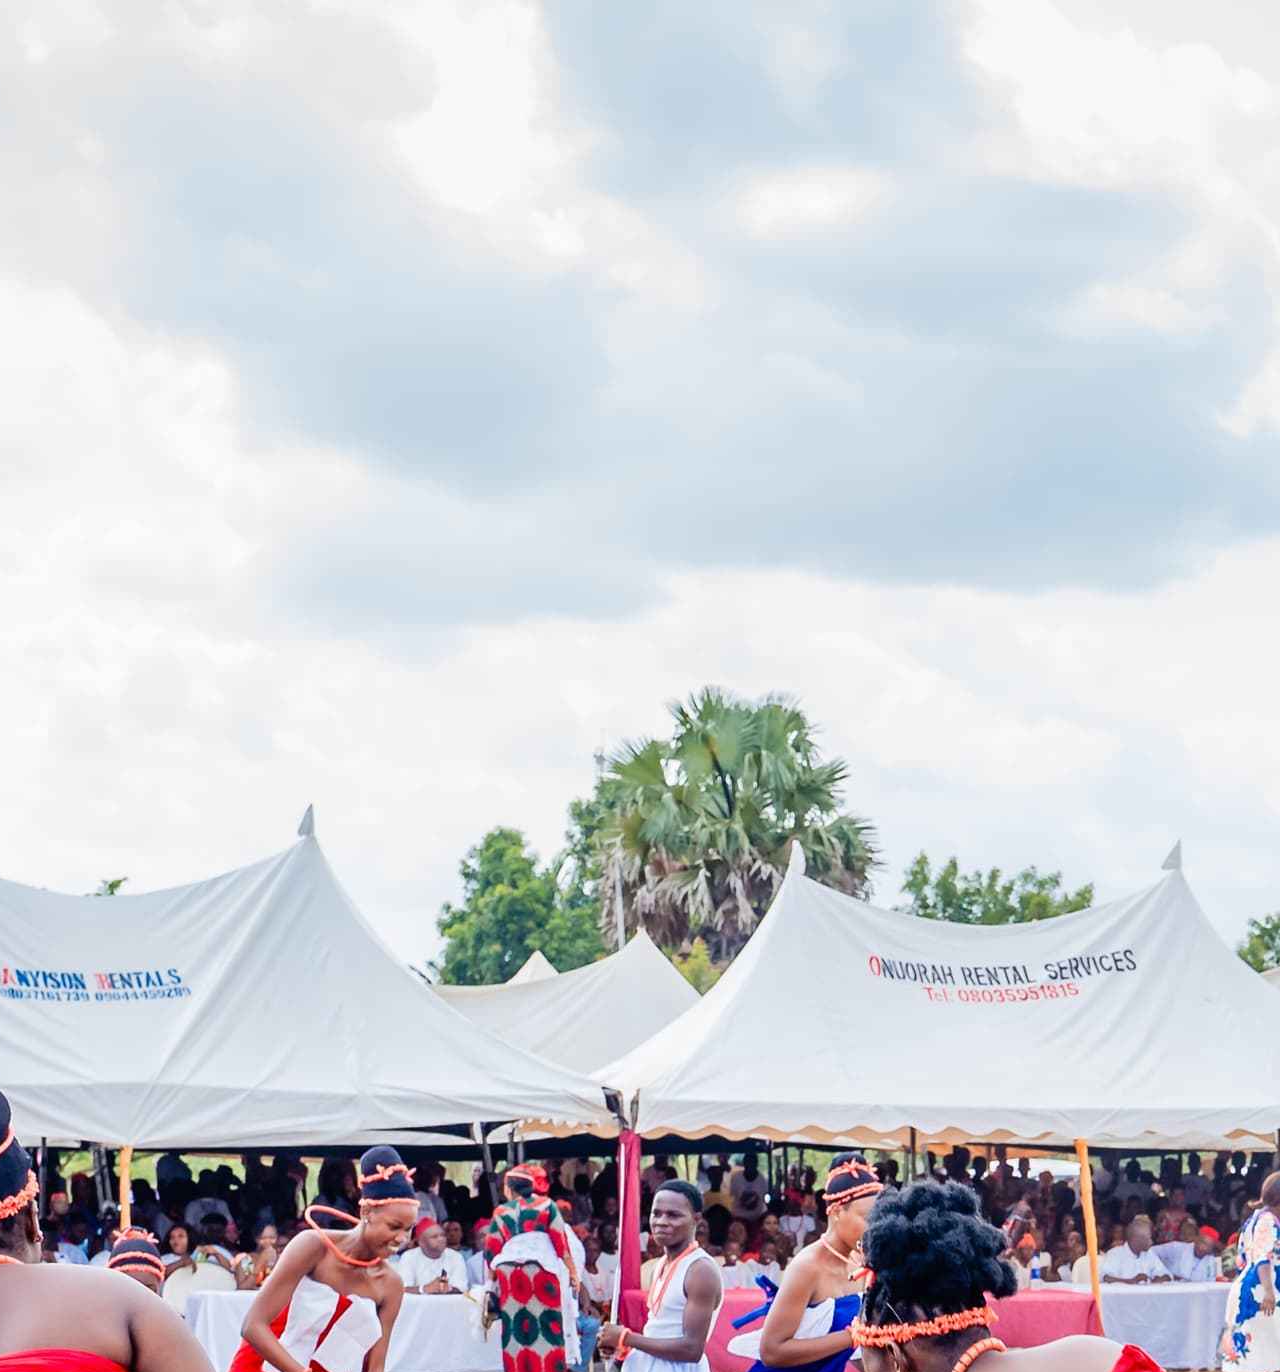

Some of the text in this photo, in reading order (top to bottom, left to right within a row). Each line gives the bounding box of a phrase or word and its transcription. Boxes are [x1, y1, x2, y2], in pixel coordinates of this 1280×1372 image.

[93, 968, 182, 989] RENTALS
[868, 949, 1137, 986] ONUORAH RENTAL SERVICES
